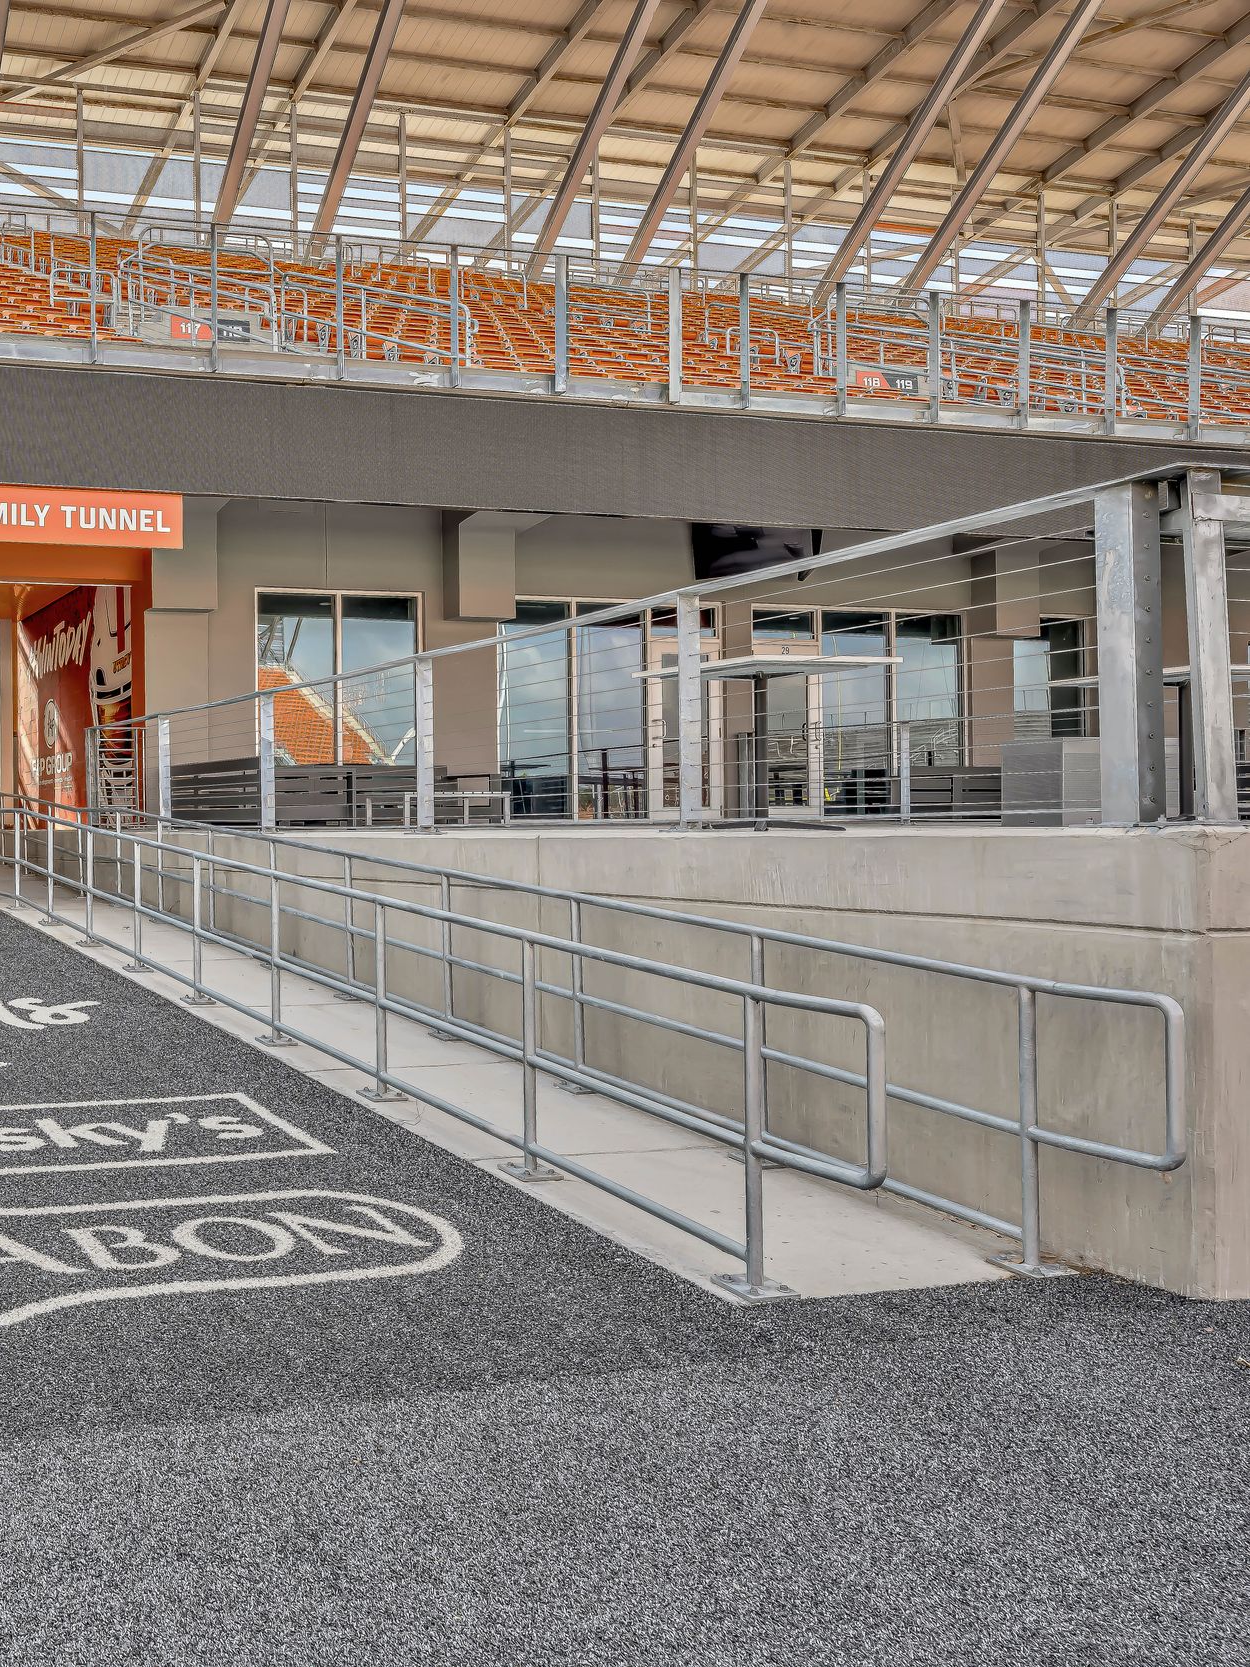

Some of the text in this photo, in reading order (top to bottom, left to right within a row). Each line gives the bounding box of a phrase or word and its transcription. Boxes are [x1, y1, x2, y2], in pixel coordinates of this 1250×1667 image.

[863, 377, 880, 387] 118
[896, 379, 913, 389] 119
[60, 505, 171, 533] TUNNEL
[781, 646, 790, 655] 29
[46, 752, 72, 775] GROUP
